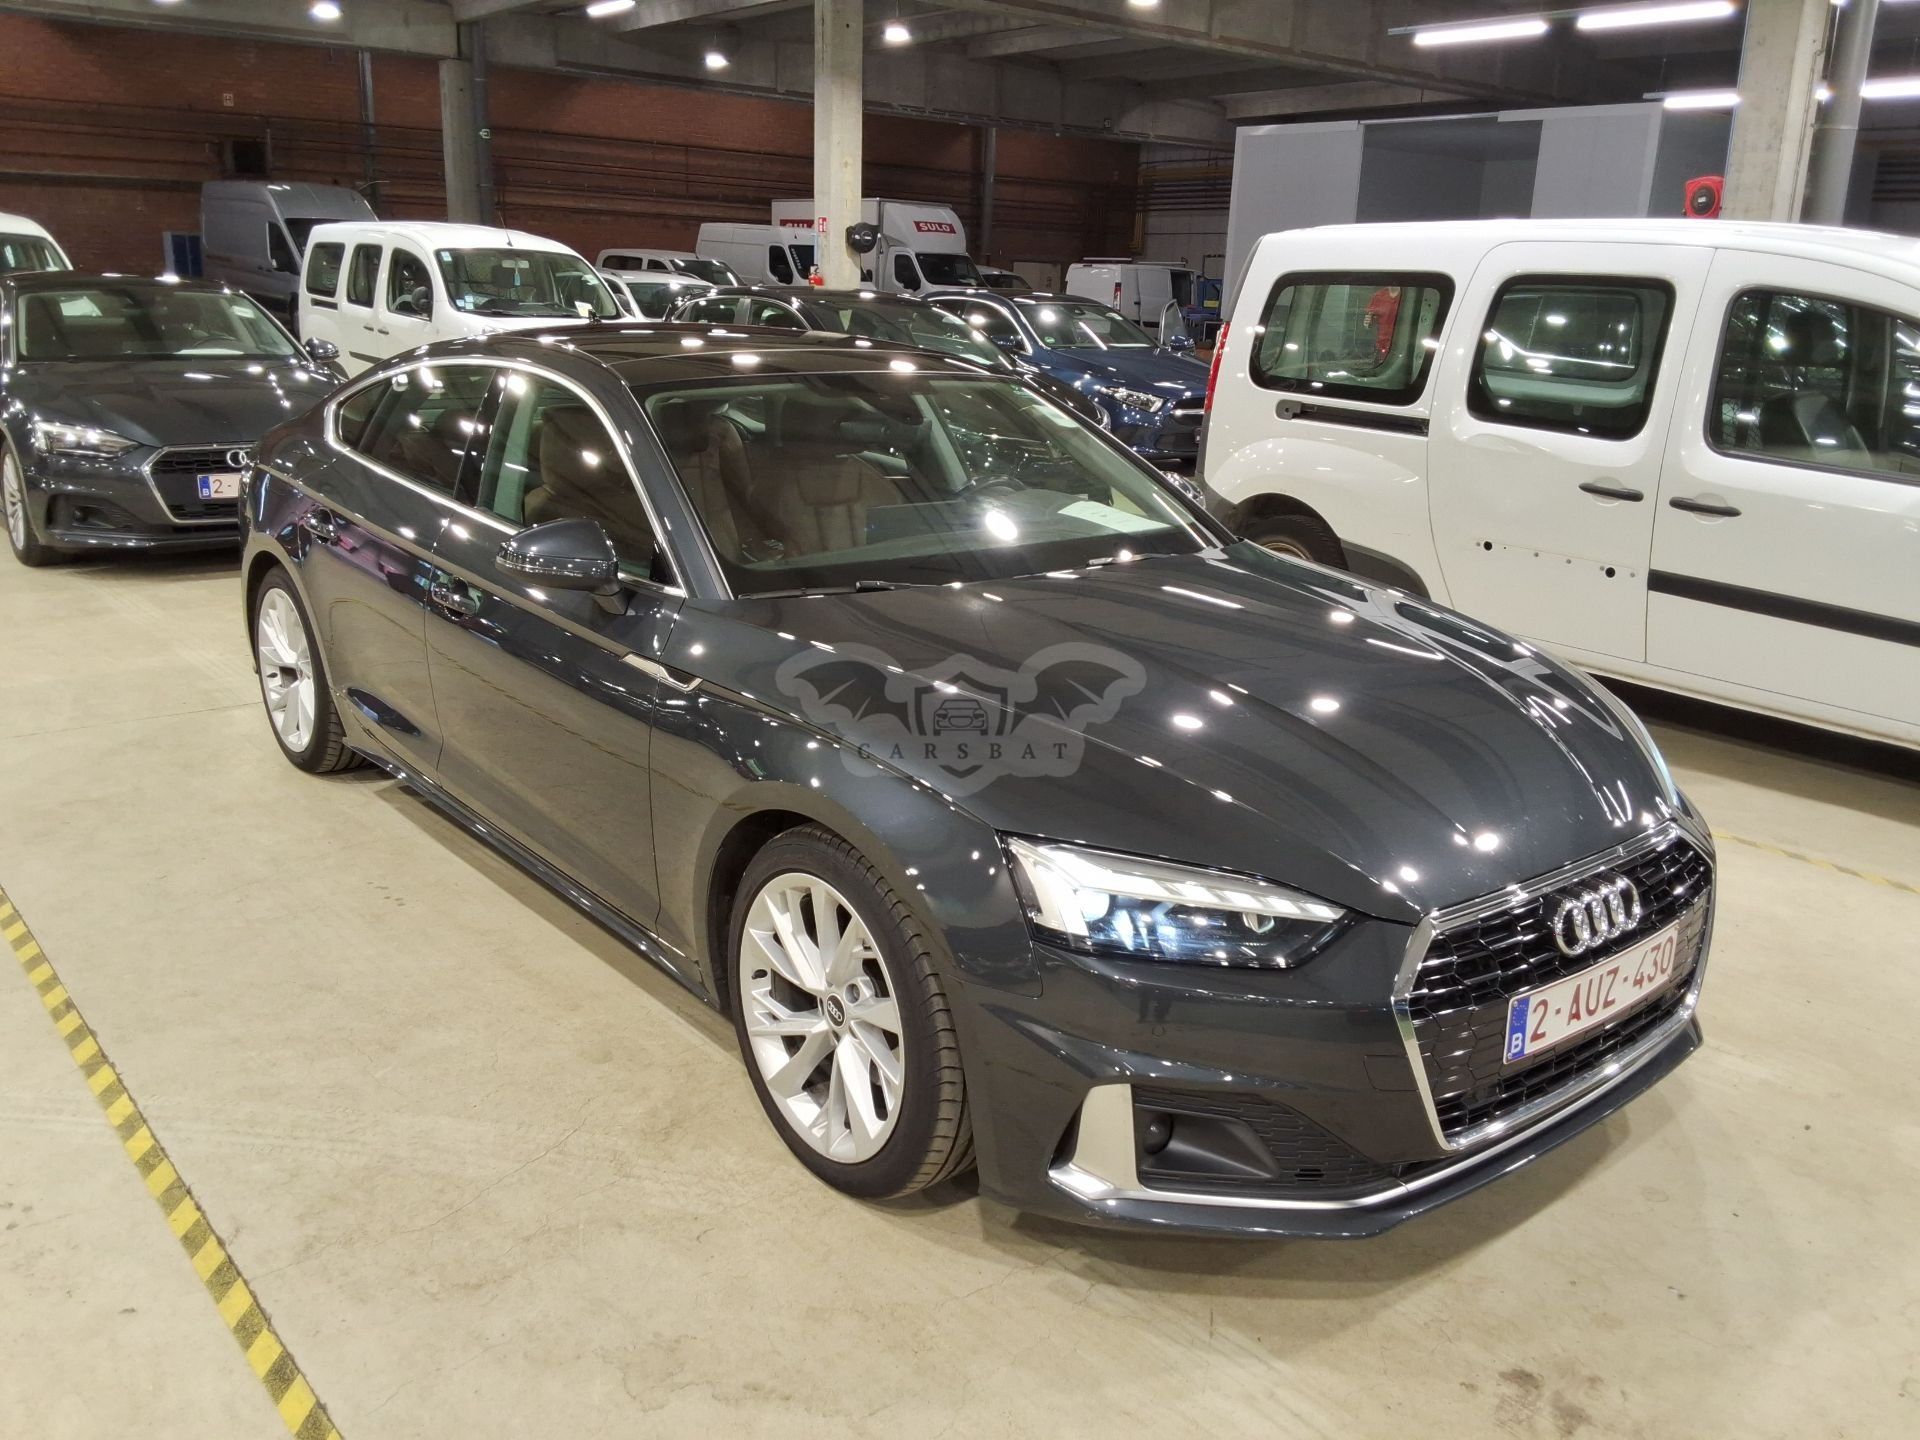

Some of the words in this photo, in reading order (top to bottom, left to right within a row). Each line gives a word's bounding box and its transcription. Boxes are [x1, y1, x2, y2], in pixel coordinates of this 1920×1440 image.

[919, 222, 951, 232] SULO
[202, 488, 210, 496] B
[1529, 935, 1674, 1043] 2-AUZ-430
[1510, 1032, 1523, 1053] B
